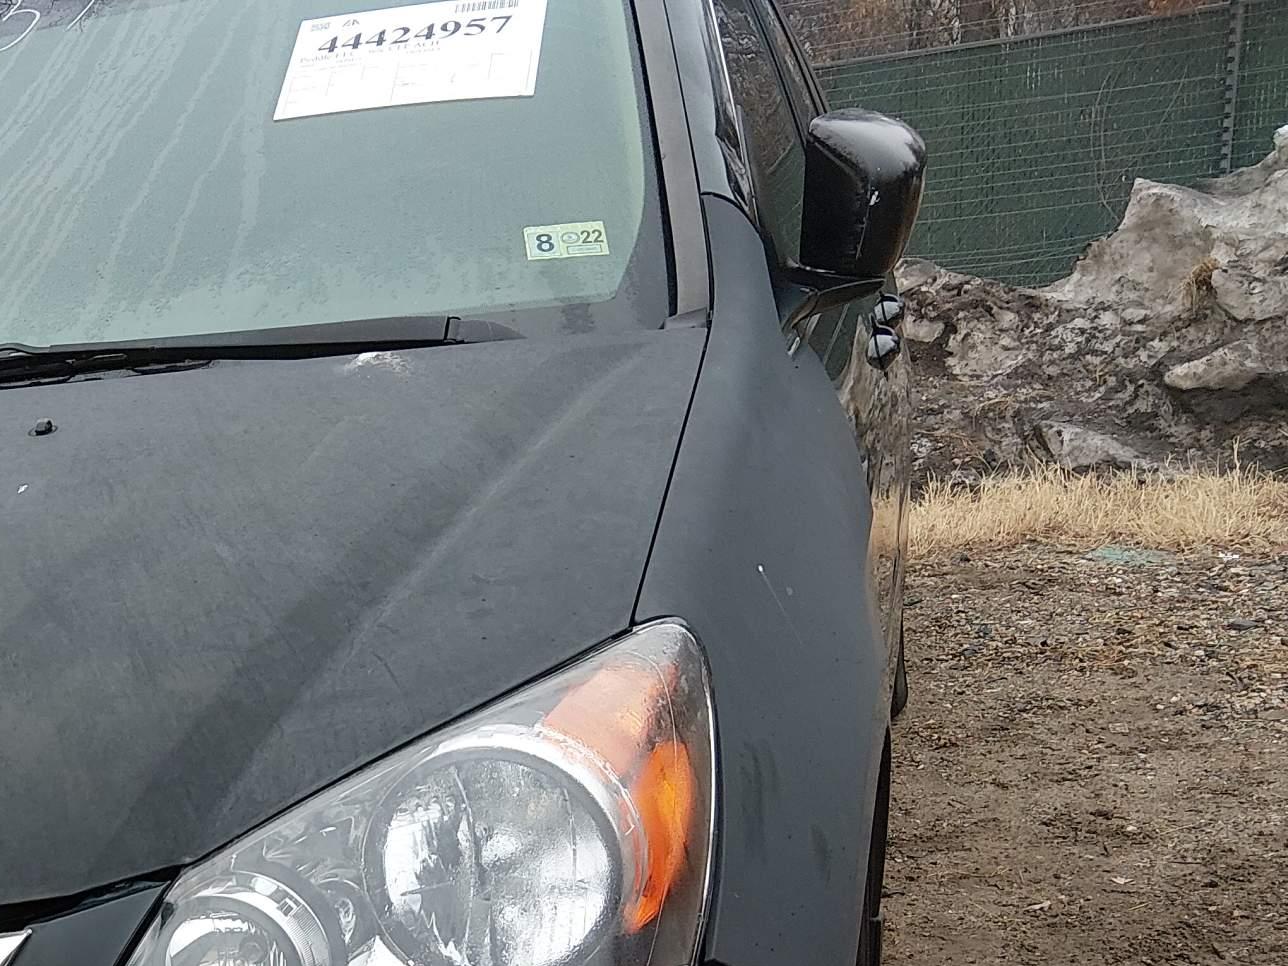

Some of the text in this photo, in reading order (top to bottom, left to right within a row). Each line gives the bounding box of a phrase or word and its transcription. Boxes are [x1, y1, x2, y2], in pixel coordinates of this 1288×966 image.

[318, 15, 513, 53] 44424957
[535, 229, 604, 252] 8 22
